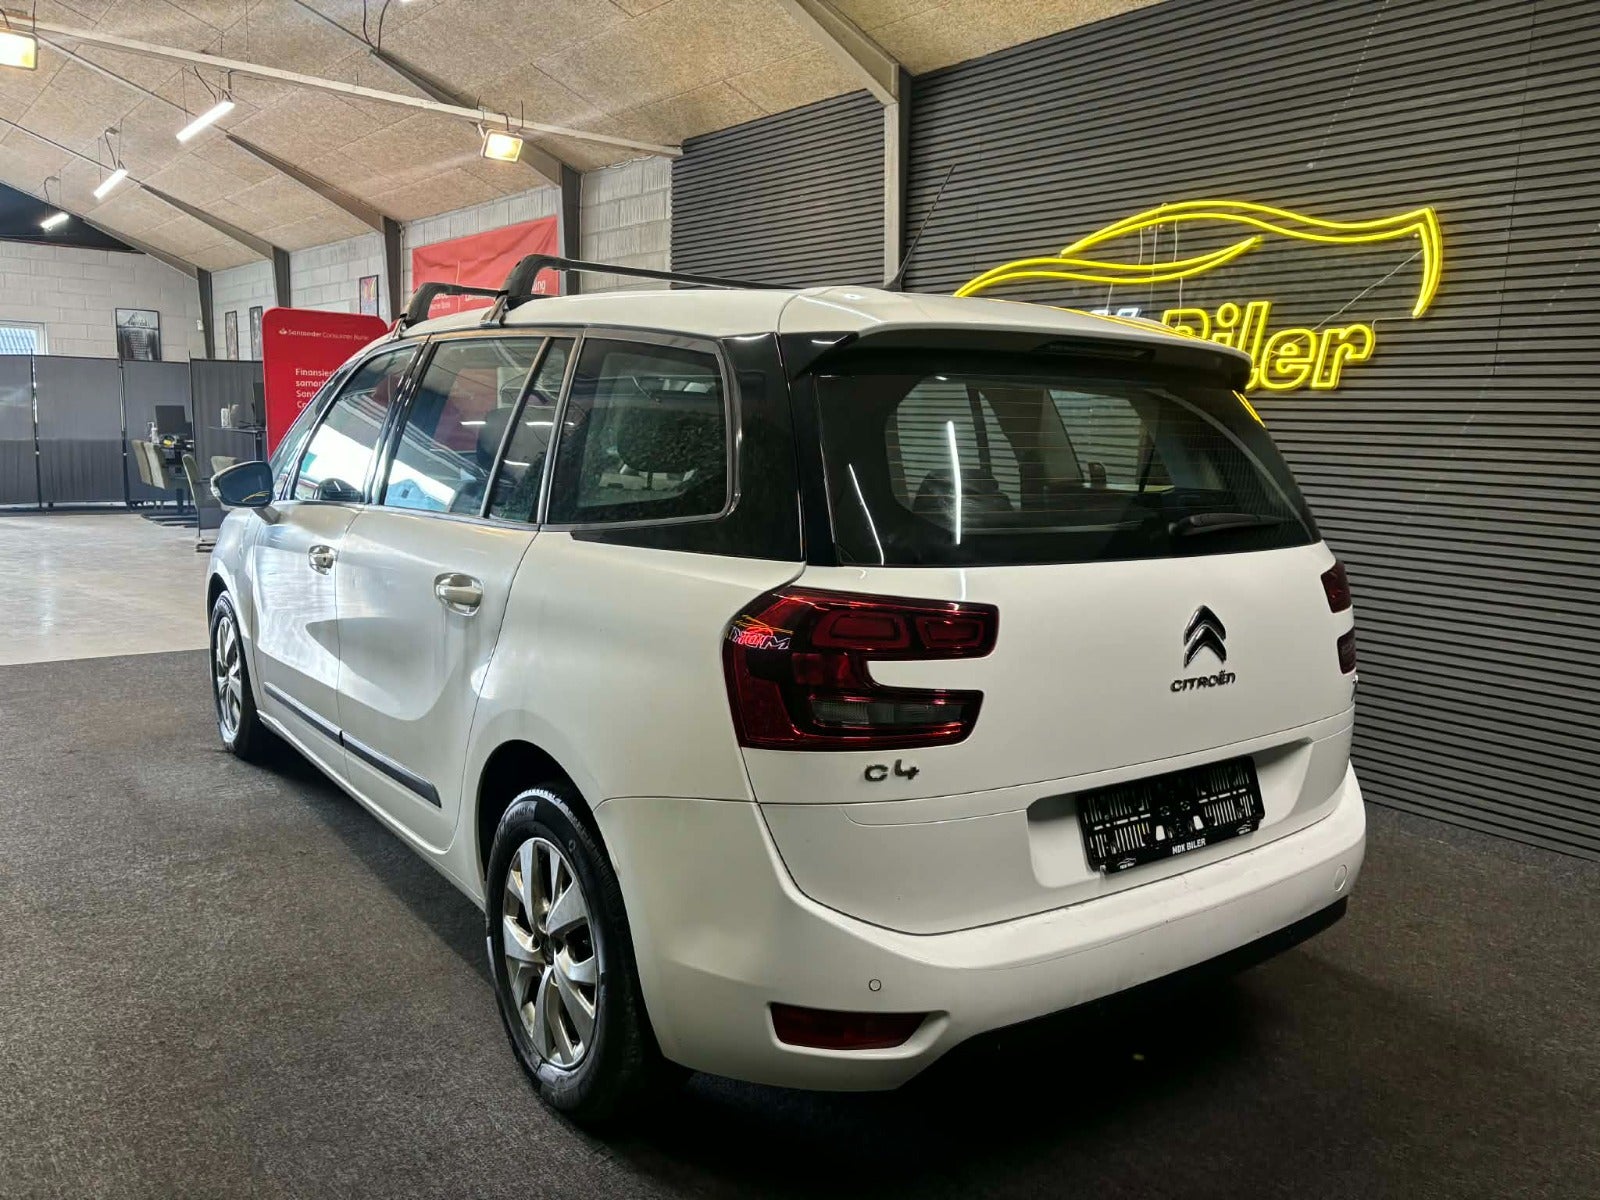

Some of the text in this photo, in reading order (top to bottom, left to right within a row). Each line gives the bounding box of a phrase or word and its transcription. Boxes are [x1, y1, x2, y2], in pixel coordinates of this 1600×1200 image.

[1170, 669, 1236, 692] CITROËN
[864, 759, 920, 781] C4
[1186, 837, 1207, 851] BILER
